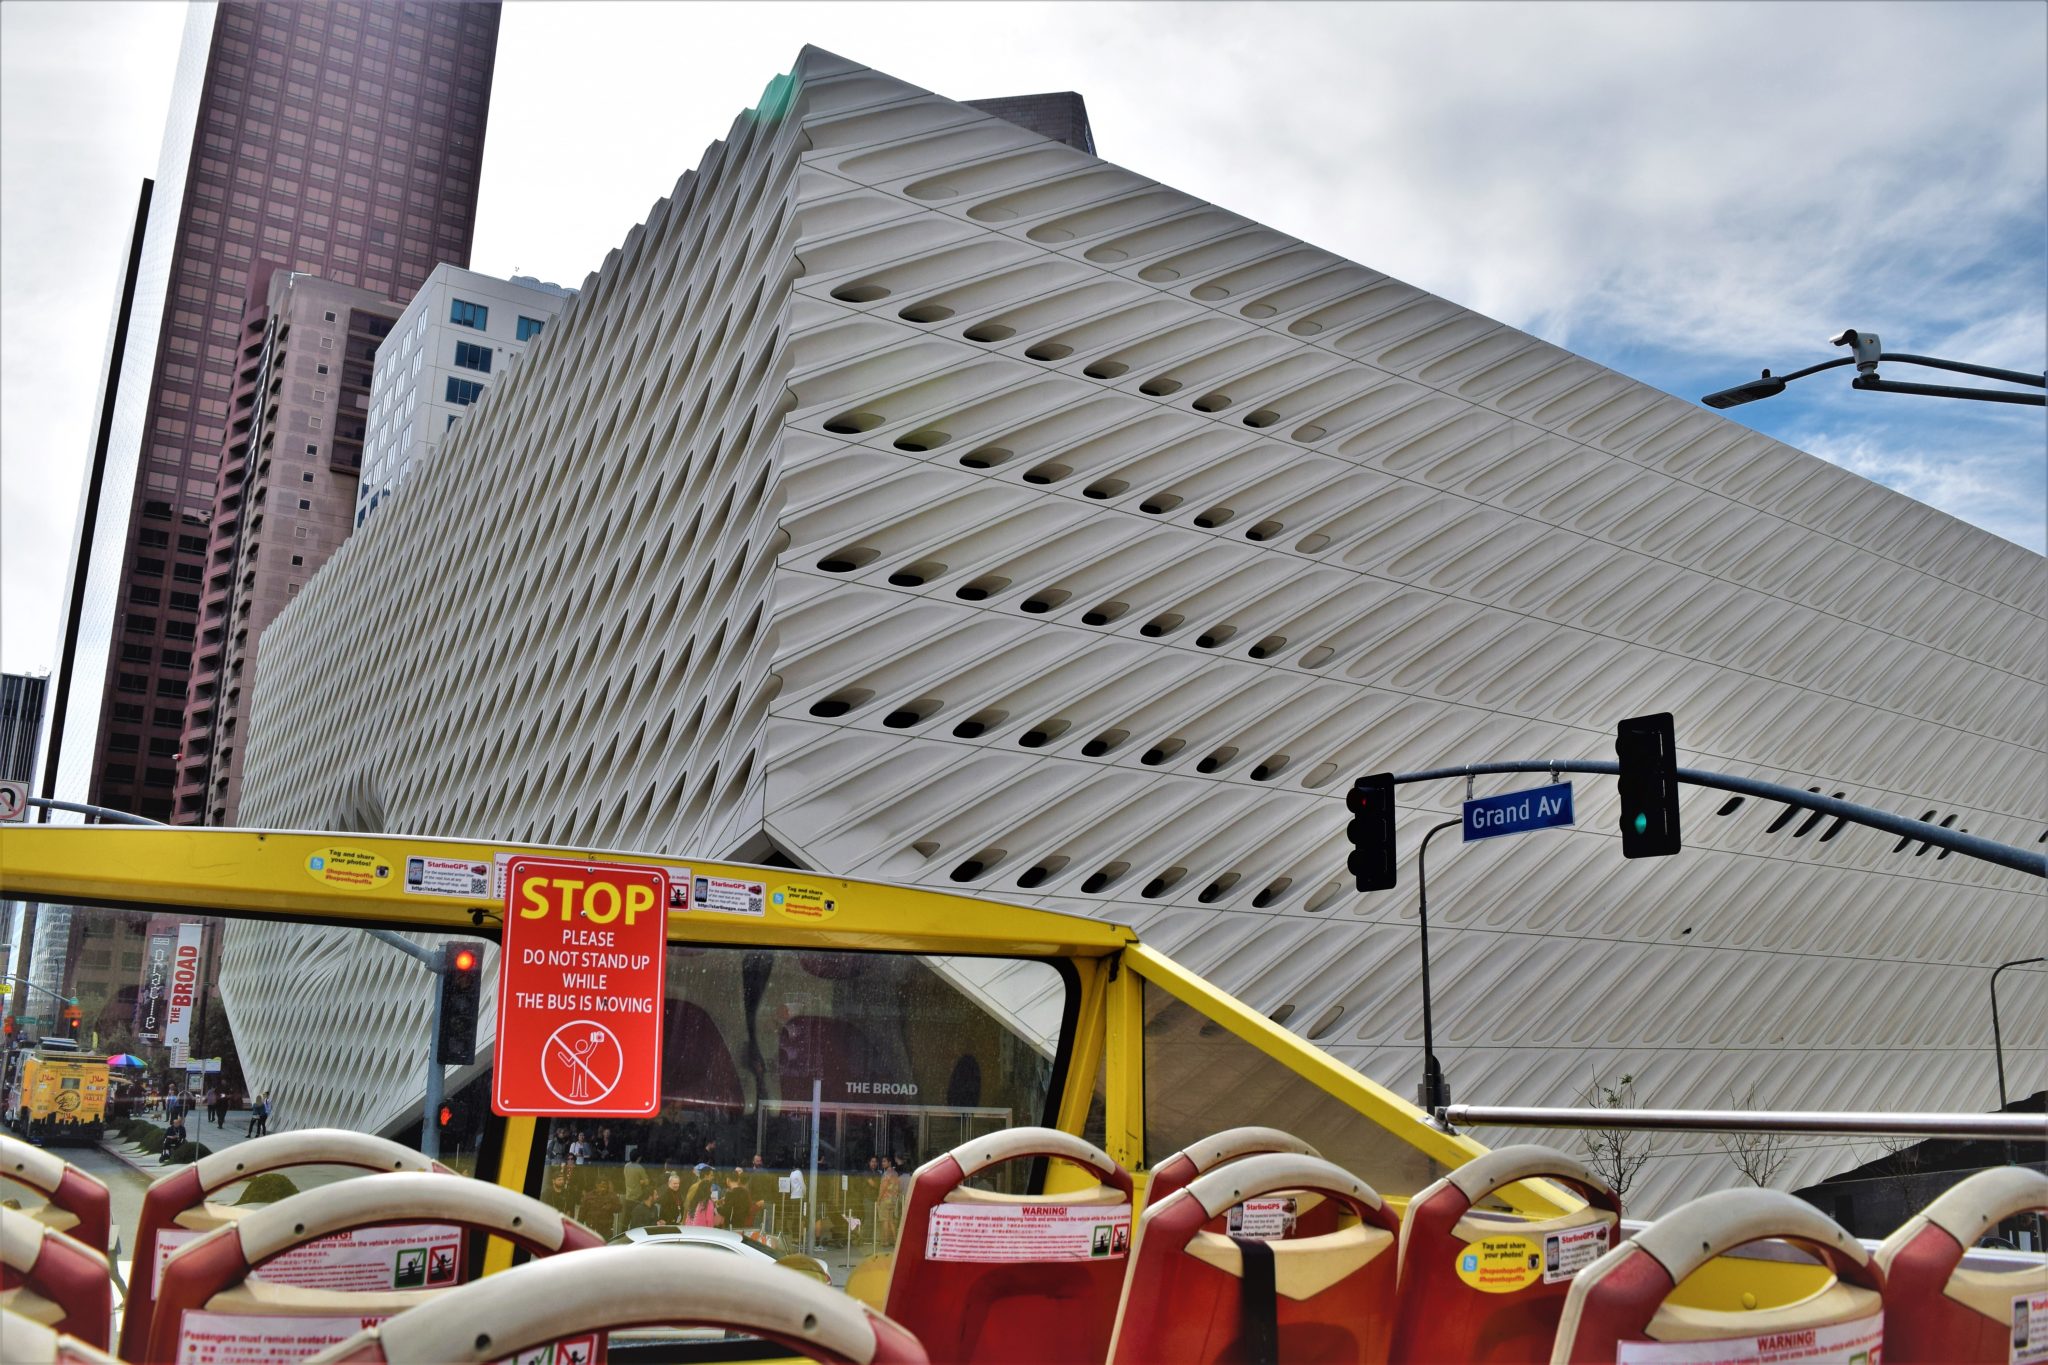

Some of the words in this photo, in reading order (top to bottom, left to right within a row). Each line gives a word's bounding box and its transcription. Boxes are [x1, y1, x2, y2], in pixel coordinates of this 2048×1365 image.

[1472, 798, 1530, 829] Grand
[1537, 795, 1562, 818] Av
[329, 849, 342, 857] Tag
[356, 852, 375, 861] share
[346, 859, 372, 867] photos!
[427, 861, 469, 870] StarlineGPS
[710, 880, 746, 890] StarlineGPS
[520, 876, 655, 925] STOP
[563, 929, 615, 947] PLEASE
[523, 948, 546, 965] DO
[548, 950, 579, 967] NOT
[581, 952, 629, 970] STAND
[632, 954, 650, 970] UP
[172, 945, 198, 1007] BROAD
[562, 973, 607, 990] WHILE
[516, 992, 544, 1009] THE
[547, 993, 576, 1011] BUS
[580, 995, 592, 1011] IS
[595, 996, 653, 1014] MOVING
[170, 1007, 181, 1024] THE
[845, 1081, 871, 1094] THE
[872, 1082, 919, 1096] BROAD
[1022, 1207, 1067, 1216] WARNING!
[1246, 1203, 1280, 1211] StarlineGPS
[368, 1239, 389, 1247] vehicle
[390, 1238, 406, 1246] while
[1561, 1230, 1595, 1245] StarlineGPS
[1482, 1242, 1494, 1251] Tag
[1509, 1241, 1526, 1249] share
[1484, 1252, 1499, 1260] your
[1500, 1251, 1524, 1260] photos!
[184, 1330, 236, 1344] Passengers
[238, 1334, 262, 1344] must
[263, 1335, 295, 1344] remain
[296, 1335, 327, 1344] seated
[1757, 1329, 1816, 1351] WARNING!
